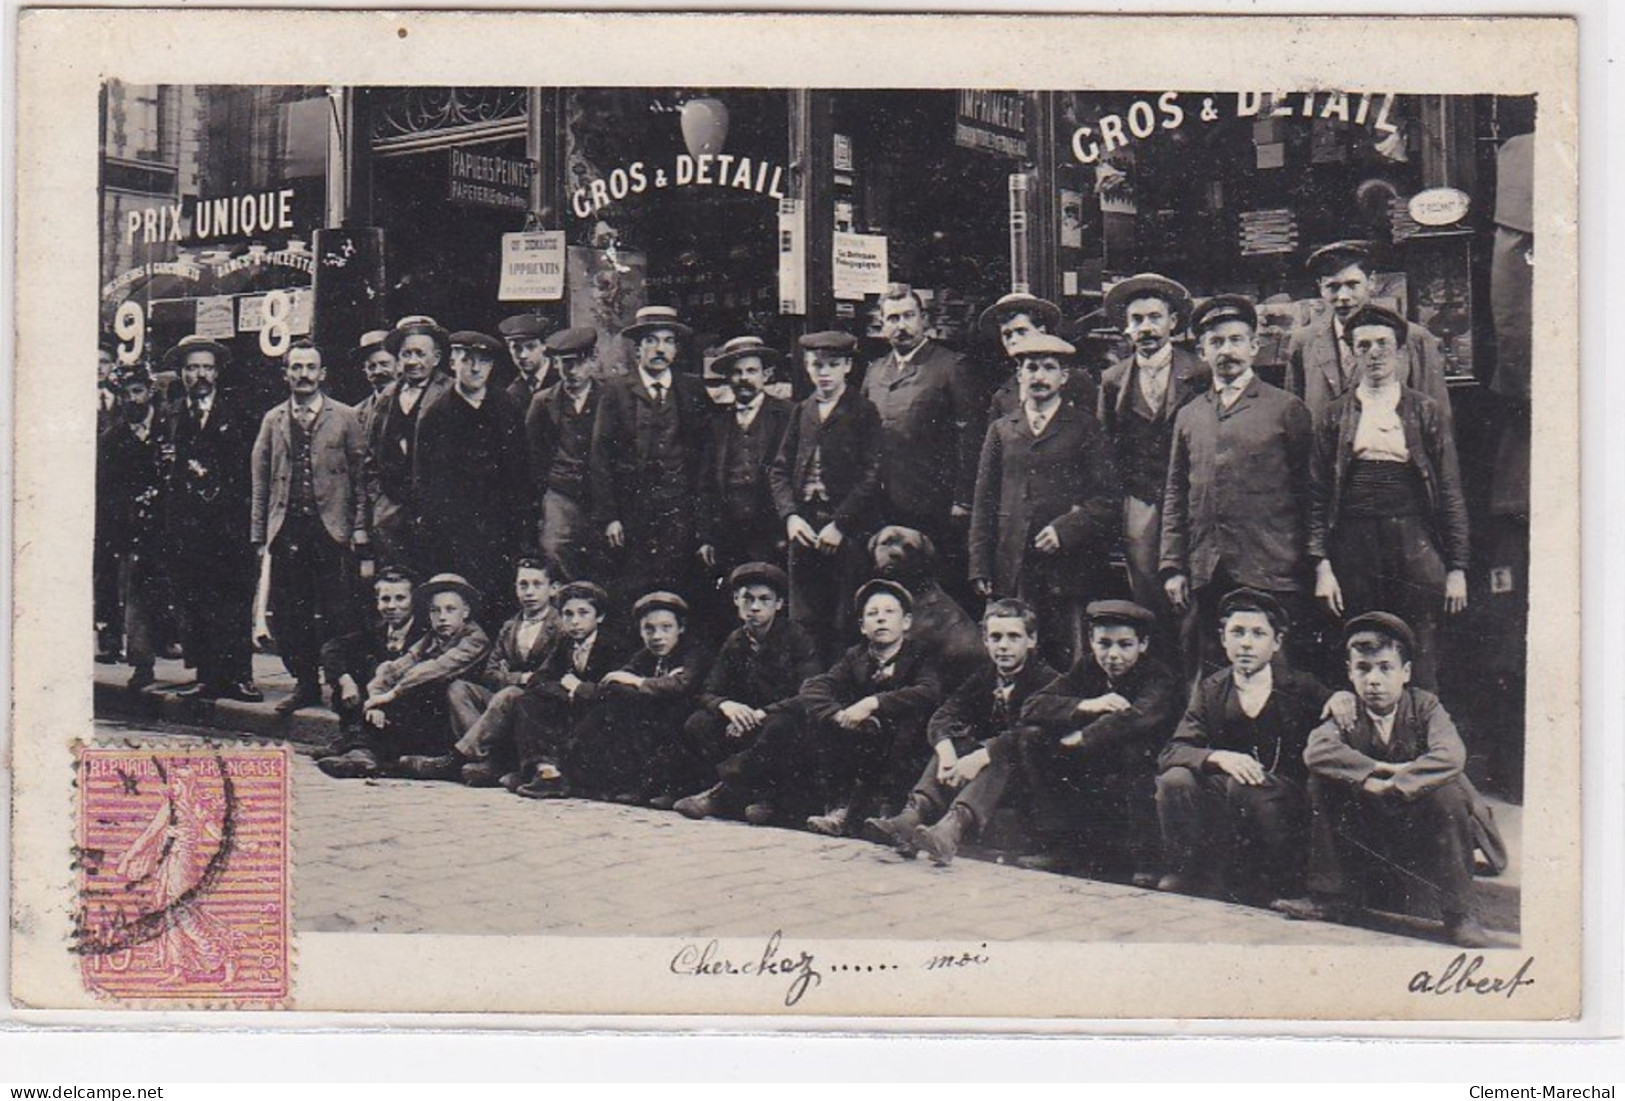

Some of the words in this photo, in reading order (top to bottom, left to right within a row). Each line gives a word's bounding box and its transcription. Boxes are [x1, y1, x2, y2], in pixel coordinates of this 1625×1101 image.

[1072, 92, 1184, 163] GROS
[1201, 98, 1218, 121] &
[128, 203, 183, 246] PRIX
[196, 189, 294, 239] UNIQUE
[573, 162, 647, 218] GROS
[655, 169, 668, 188] &
[259, 289, 292, 357] 8
